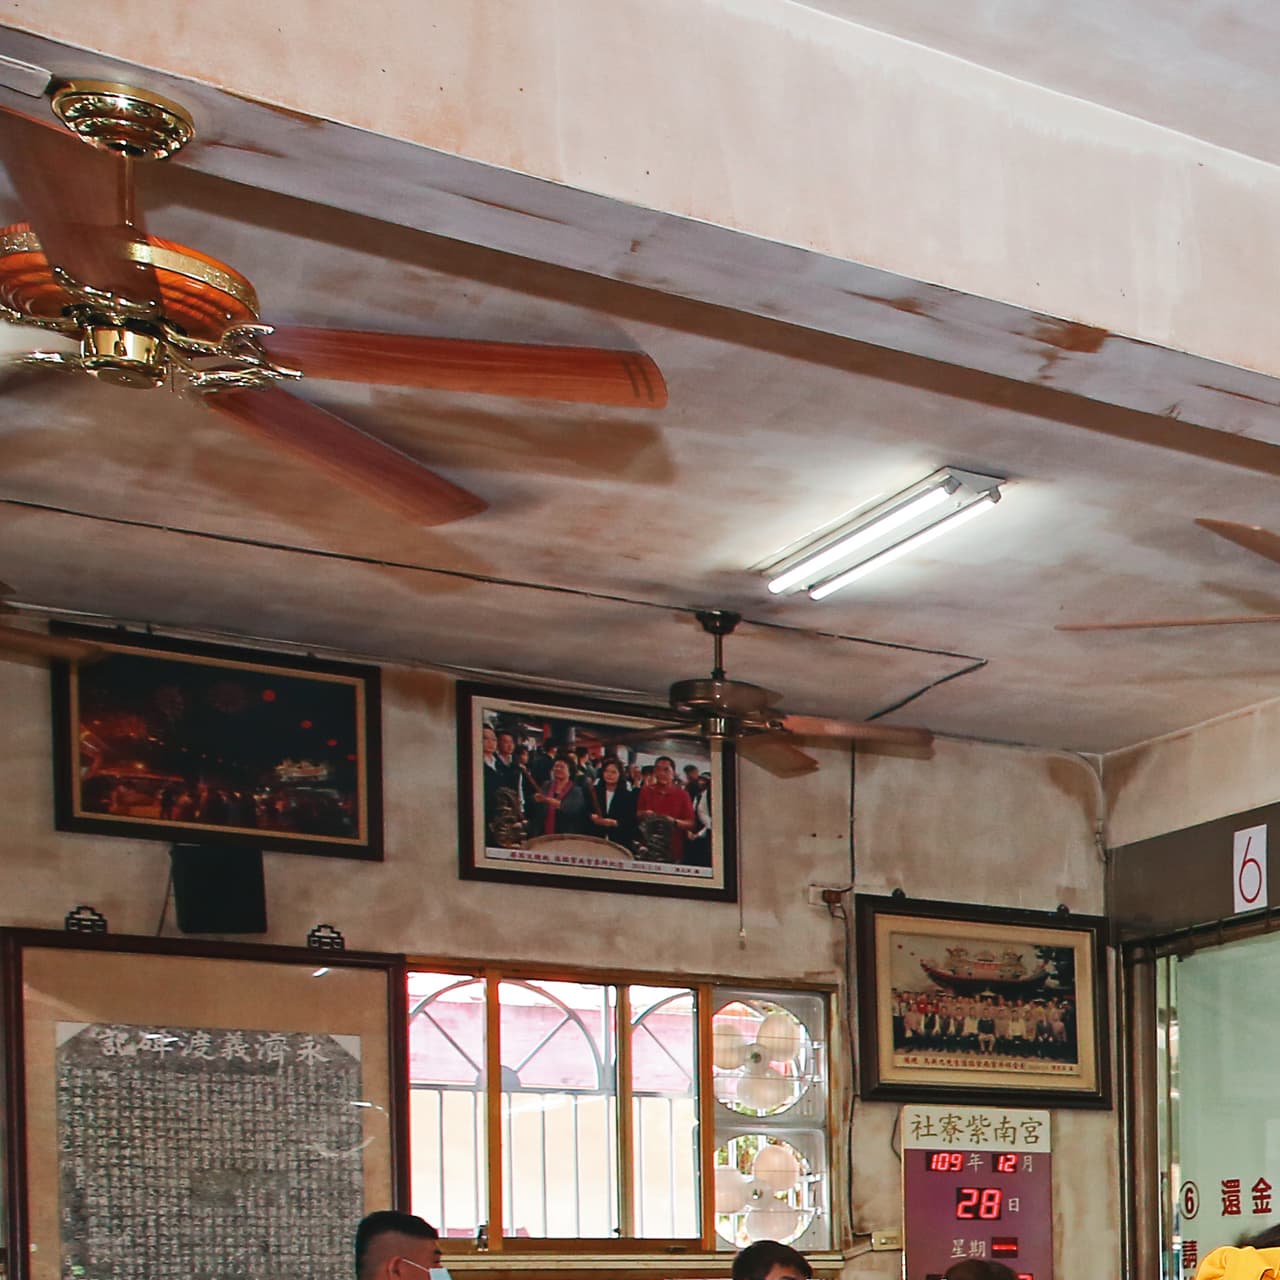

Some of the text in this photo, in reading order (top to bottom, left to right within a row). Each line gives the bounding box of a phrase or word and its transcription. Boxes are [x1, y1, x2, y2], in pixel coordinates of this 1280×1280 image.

[1238, 837, 1262, 903] 6
[911, 1113, 1043, 1145] 社寮紫南宮
[1221, 1177, 1272, 1217] 還金
